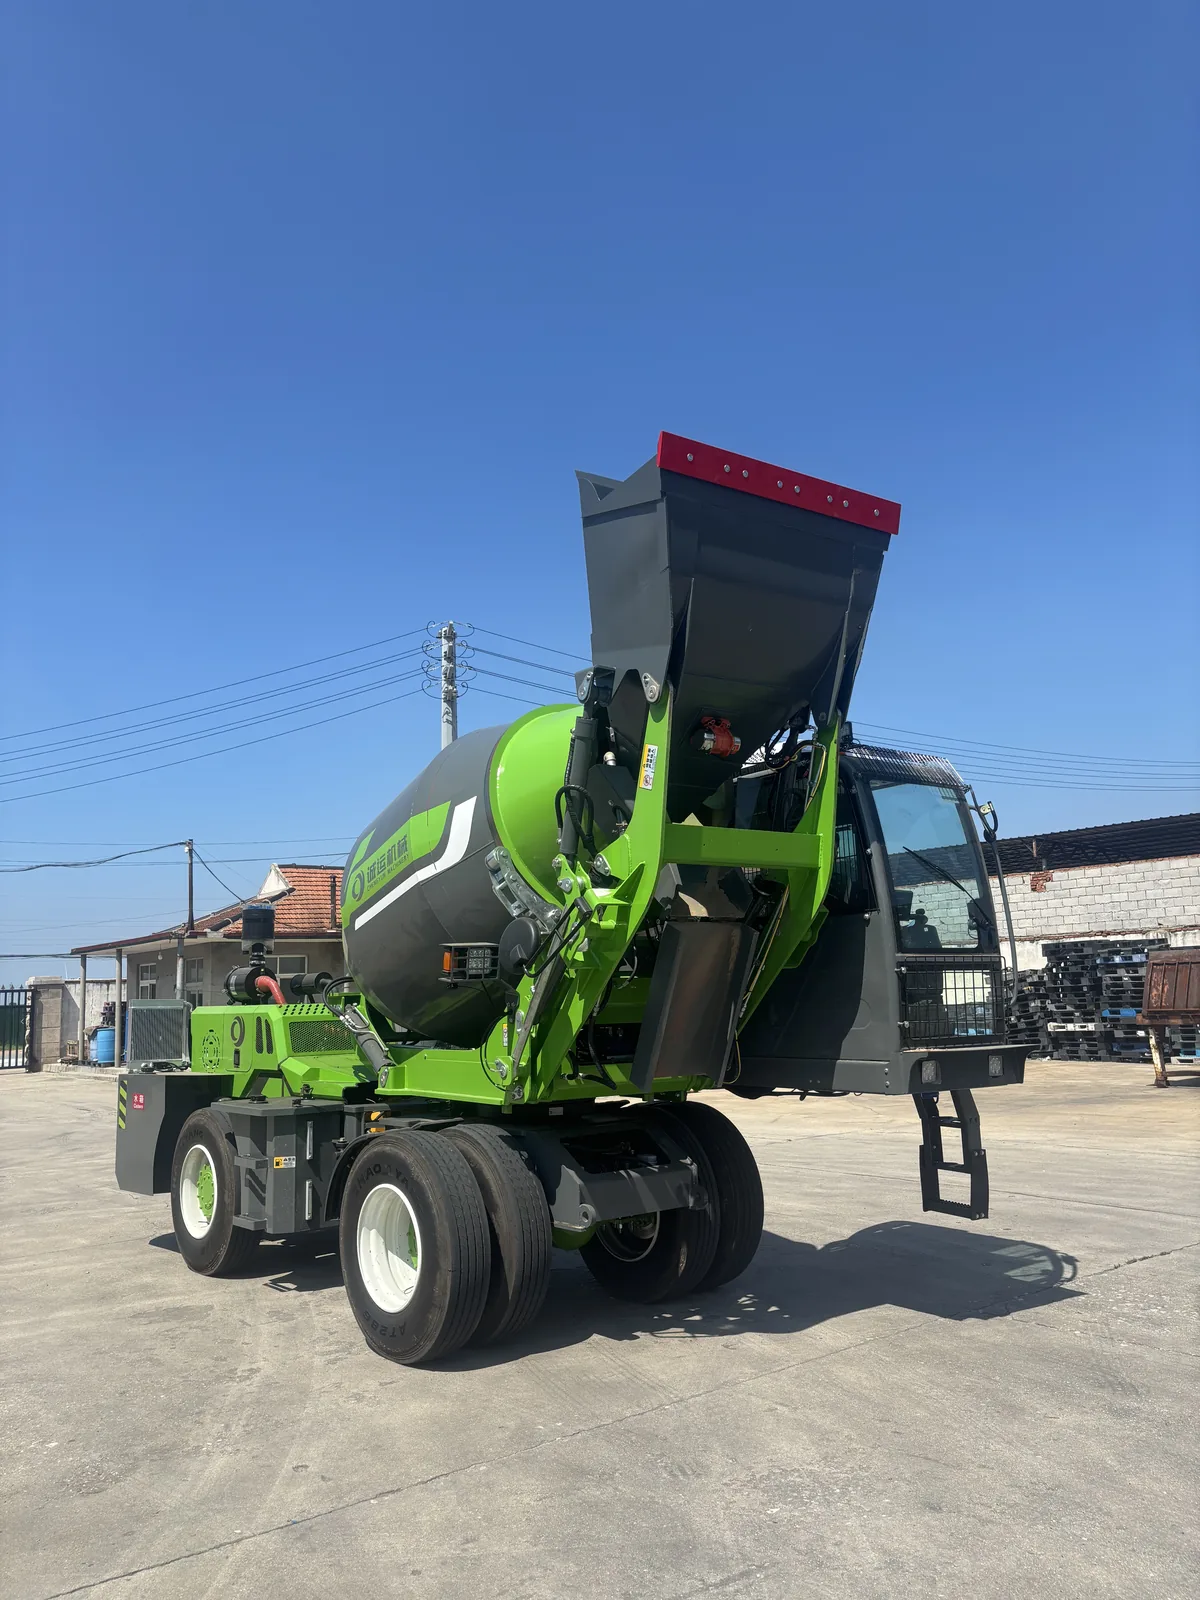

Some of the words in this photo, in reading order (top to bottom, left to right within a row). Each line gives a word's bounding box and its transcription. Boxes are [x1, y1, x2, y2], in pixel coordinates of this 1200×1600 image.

[367, 834, 408, 883] 诚运机械
[387, 853, 409, 874] MACHINERY
